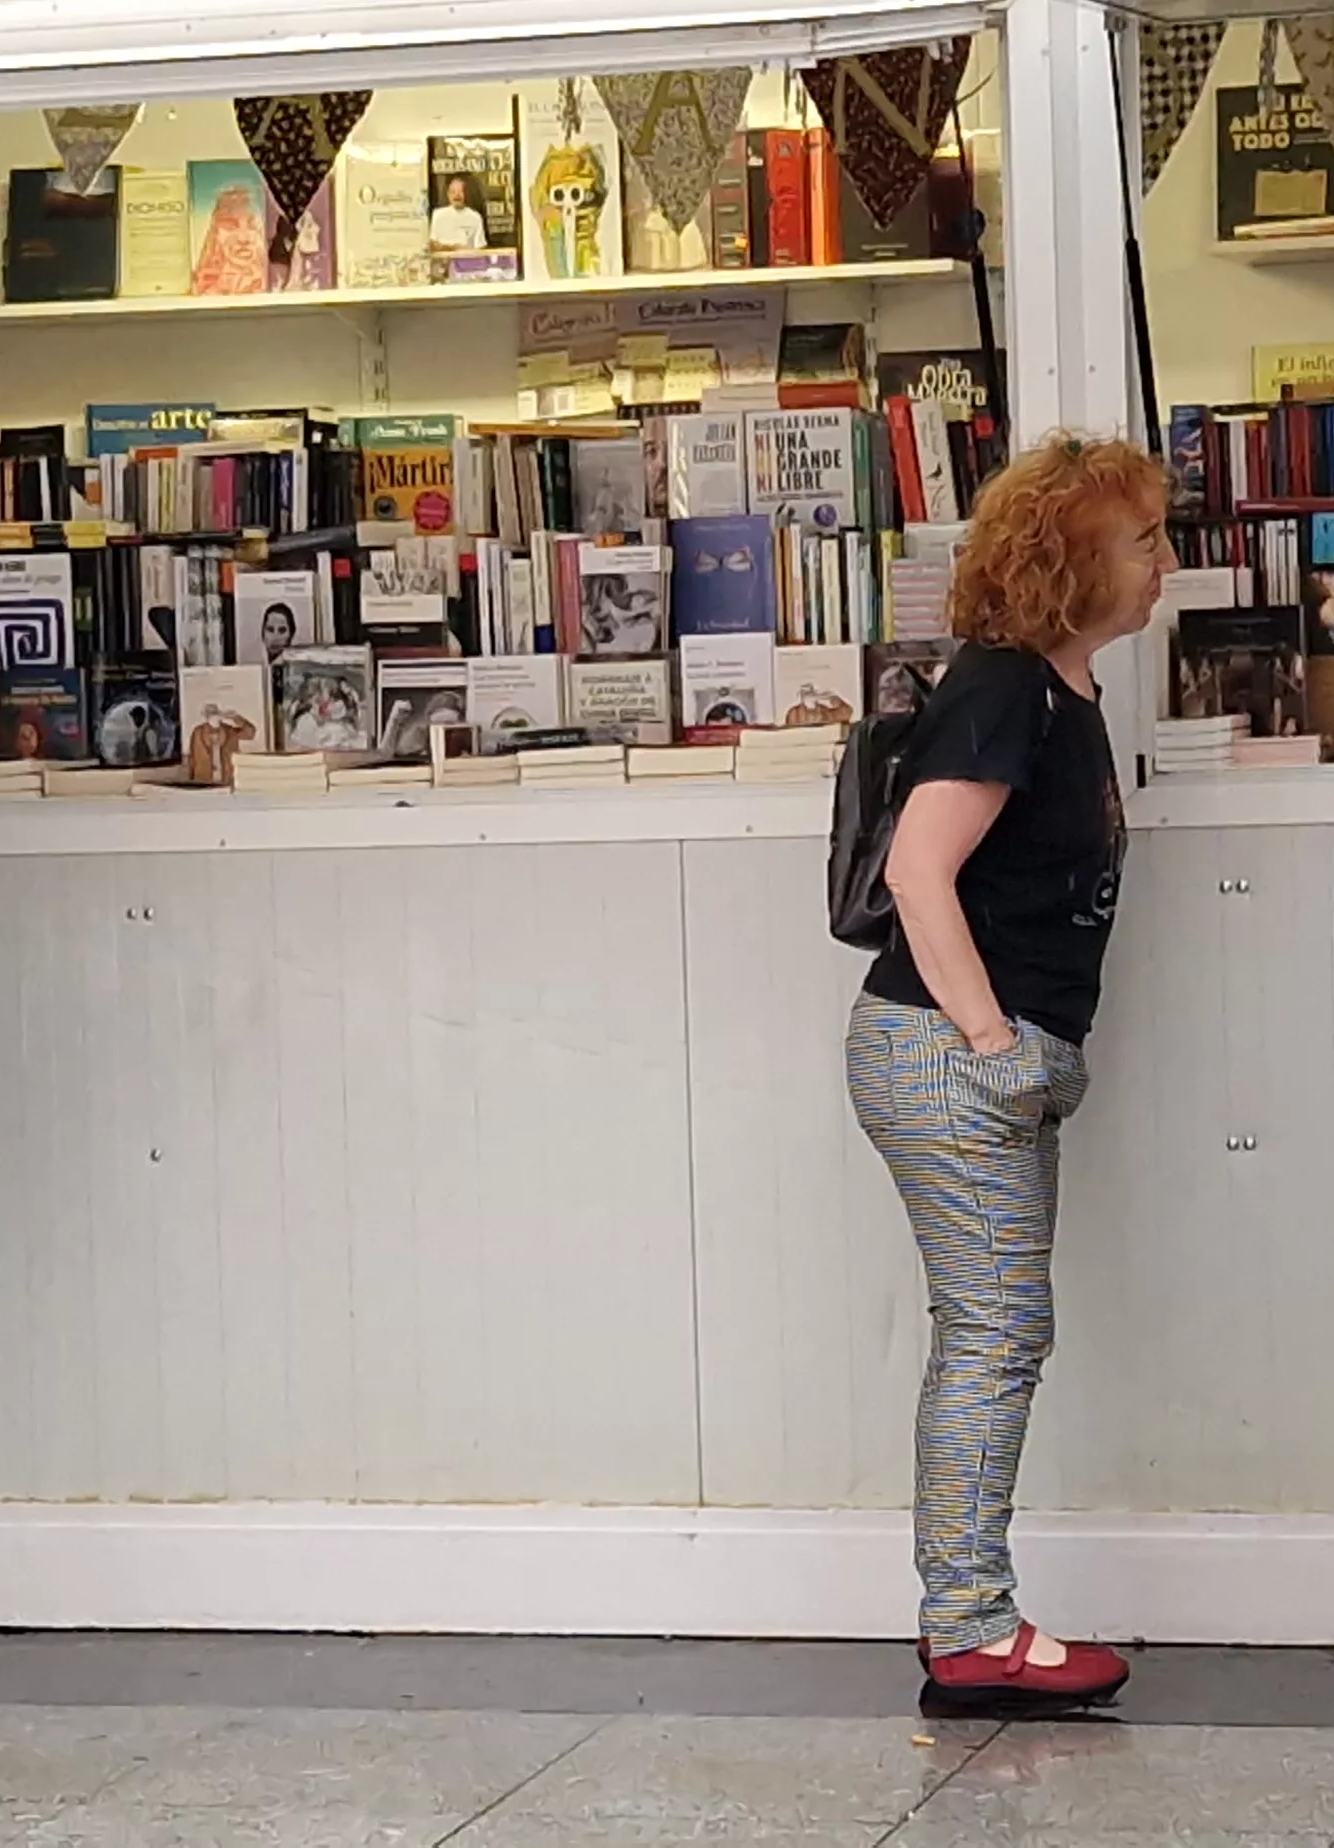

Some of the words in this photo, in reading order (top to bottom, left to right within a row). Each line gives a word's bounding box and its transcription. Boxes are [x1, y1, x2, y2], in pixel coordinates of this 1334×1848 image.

[1229, 113, 1289, 132] ANTES
[1231, 131, 1290, 151] TODO
[151, 408, 213, 431] arte
[775, 429, 810, 450] UNA
[776, 448, 842, 471] GRANDE
[777, 470, 824, 492] LIBRE
